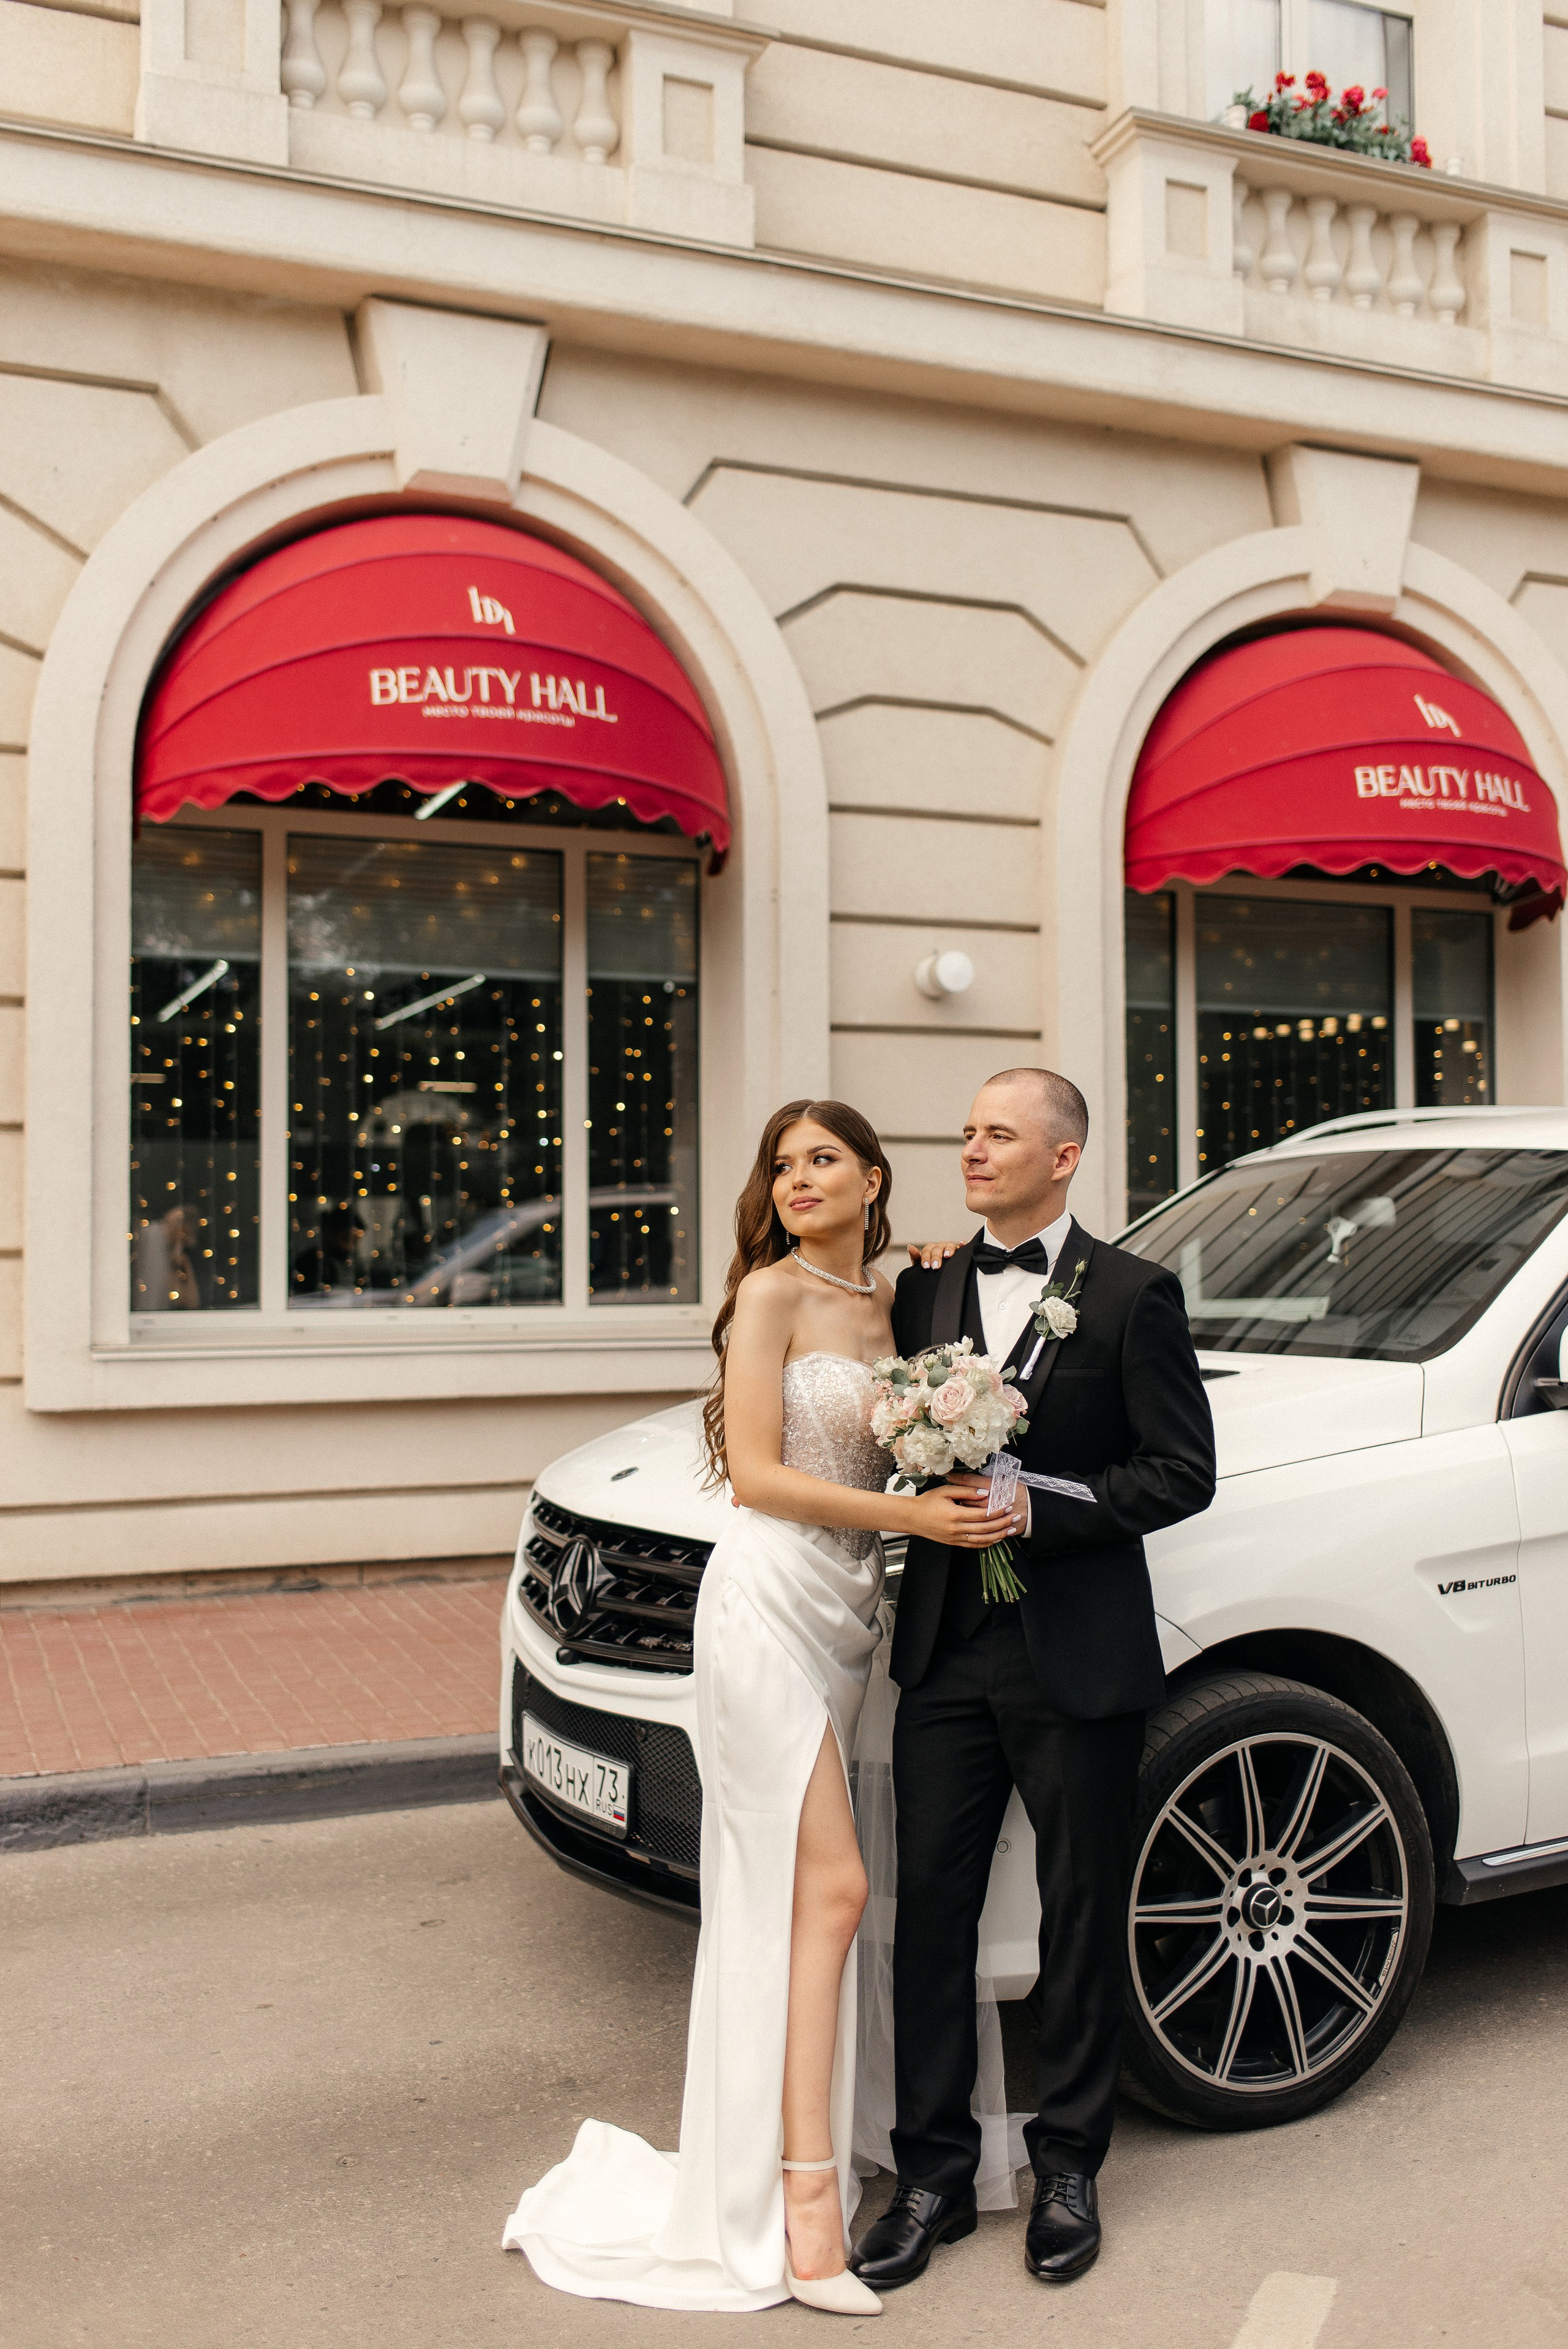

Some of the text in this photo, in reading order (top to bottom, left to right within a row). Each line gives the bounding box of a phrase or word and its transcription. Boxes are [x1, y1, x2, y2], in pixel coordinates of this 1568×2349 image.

[369, 666, 618, 723] BEAUTY HALL
[1354, 765, 1530, 812] BEAUTY HALL
[1438, 1574, 1517, 1595] V8 BITURBO
[597, 1763, 620, 1803] 73
[595, 1798, 613, 1815] RUS
